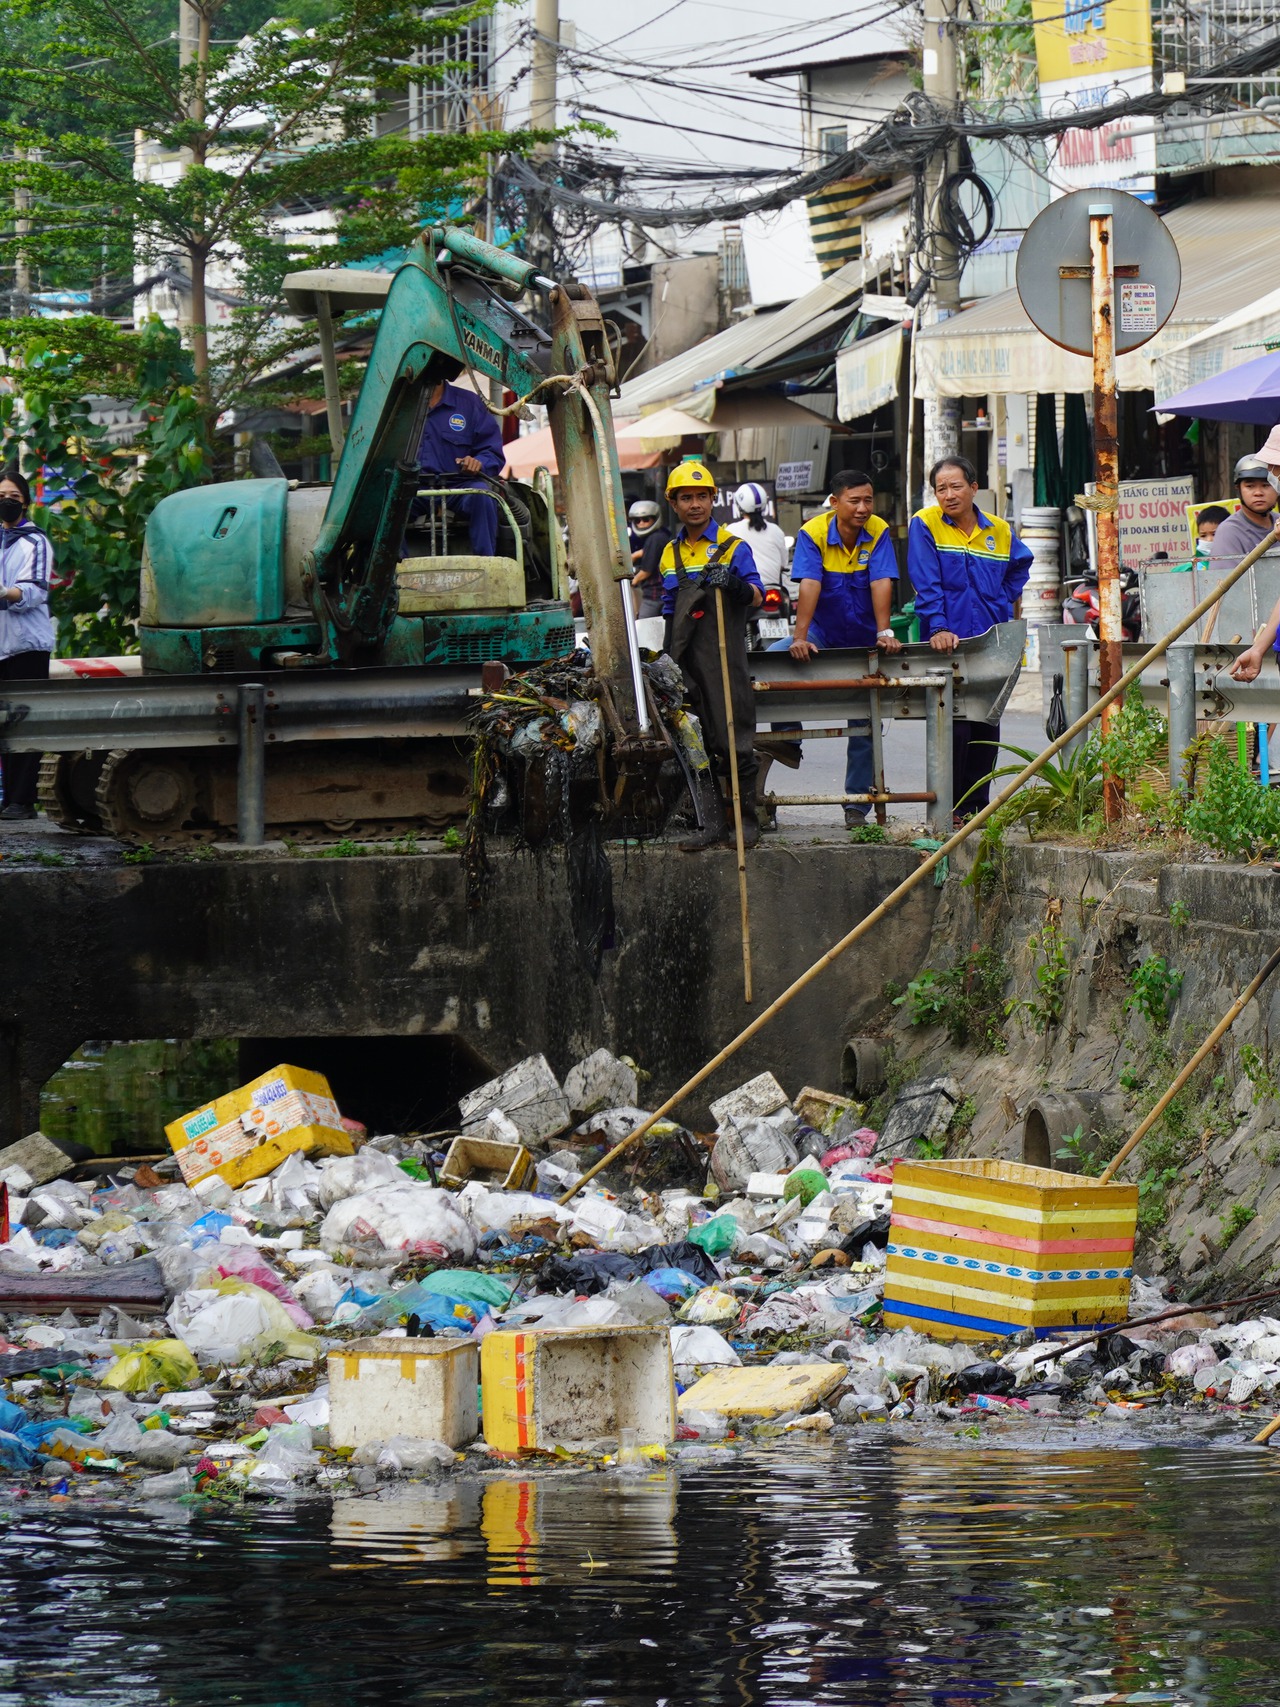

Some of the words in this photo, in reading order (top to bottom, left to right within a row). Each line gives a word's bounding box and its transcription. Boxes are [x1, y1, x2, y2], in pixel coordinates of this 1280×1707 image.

[1123, 485, 1149, 498] HÀNG
[1151, 483, 1168, 497] CHỈ
[1170, 485, 1191, 496] MAY
[1130, 524, 1160, 535] DOANH
[1172, 523, 1178, 533] &
[1123, 543, 1141, 554] MAY
